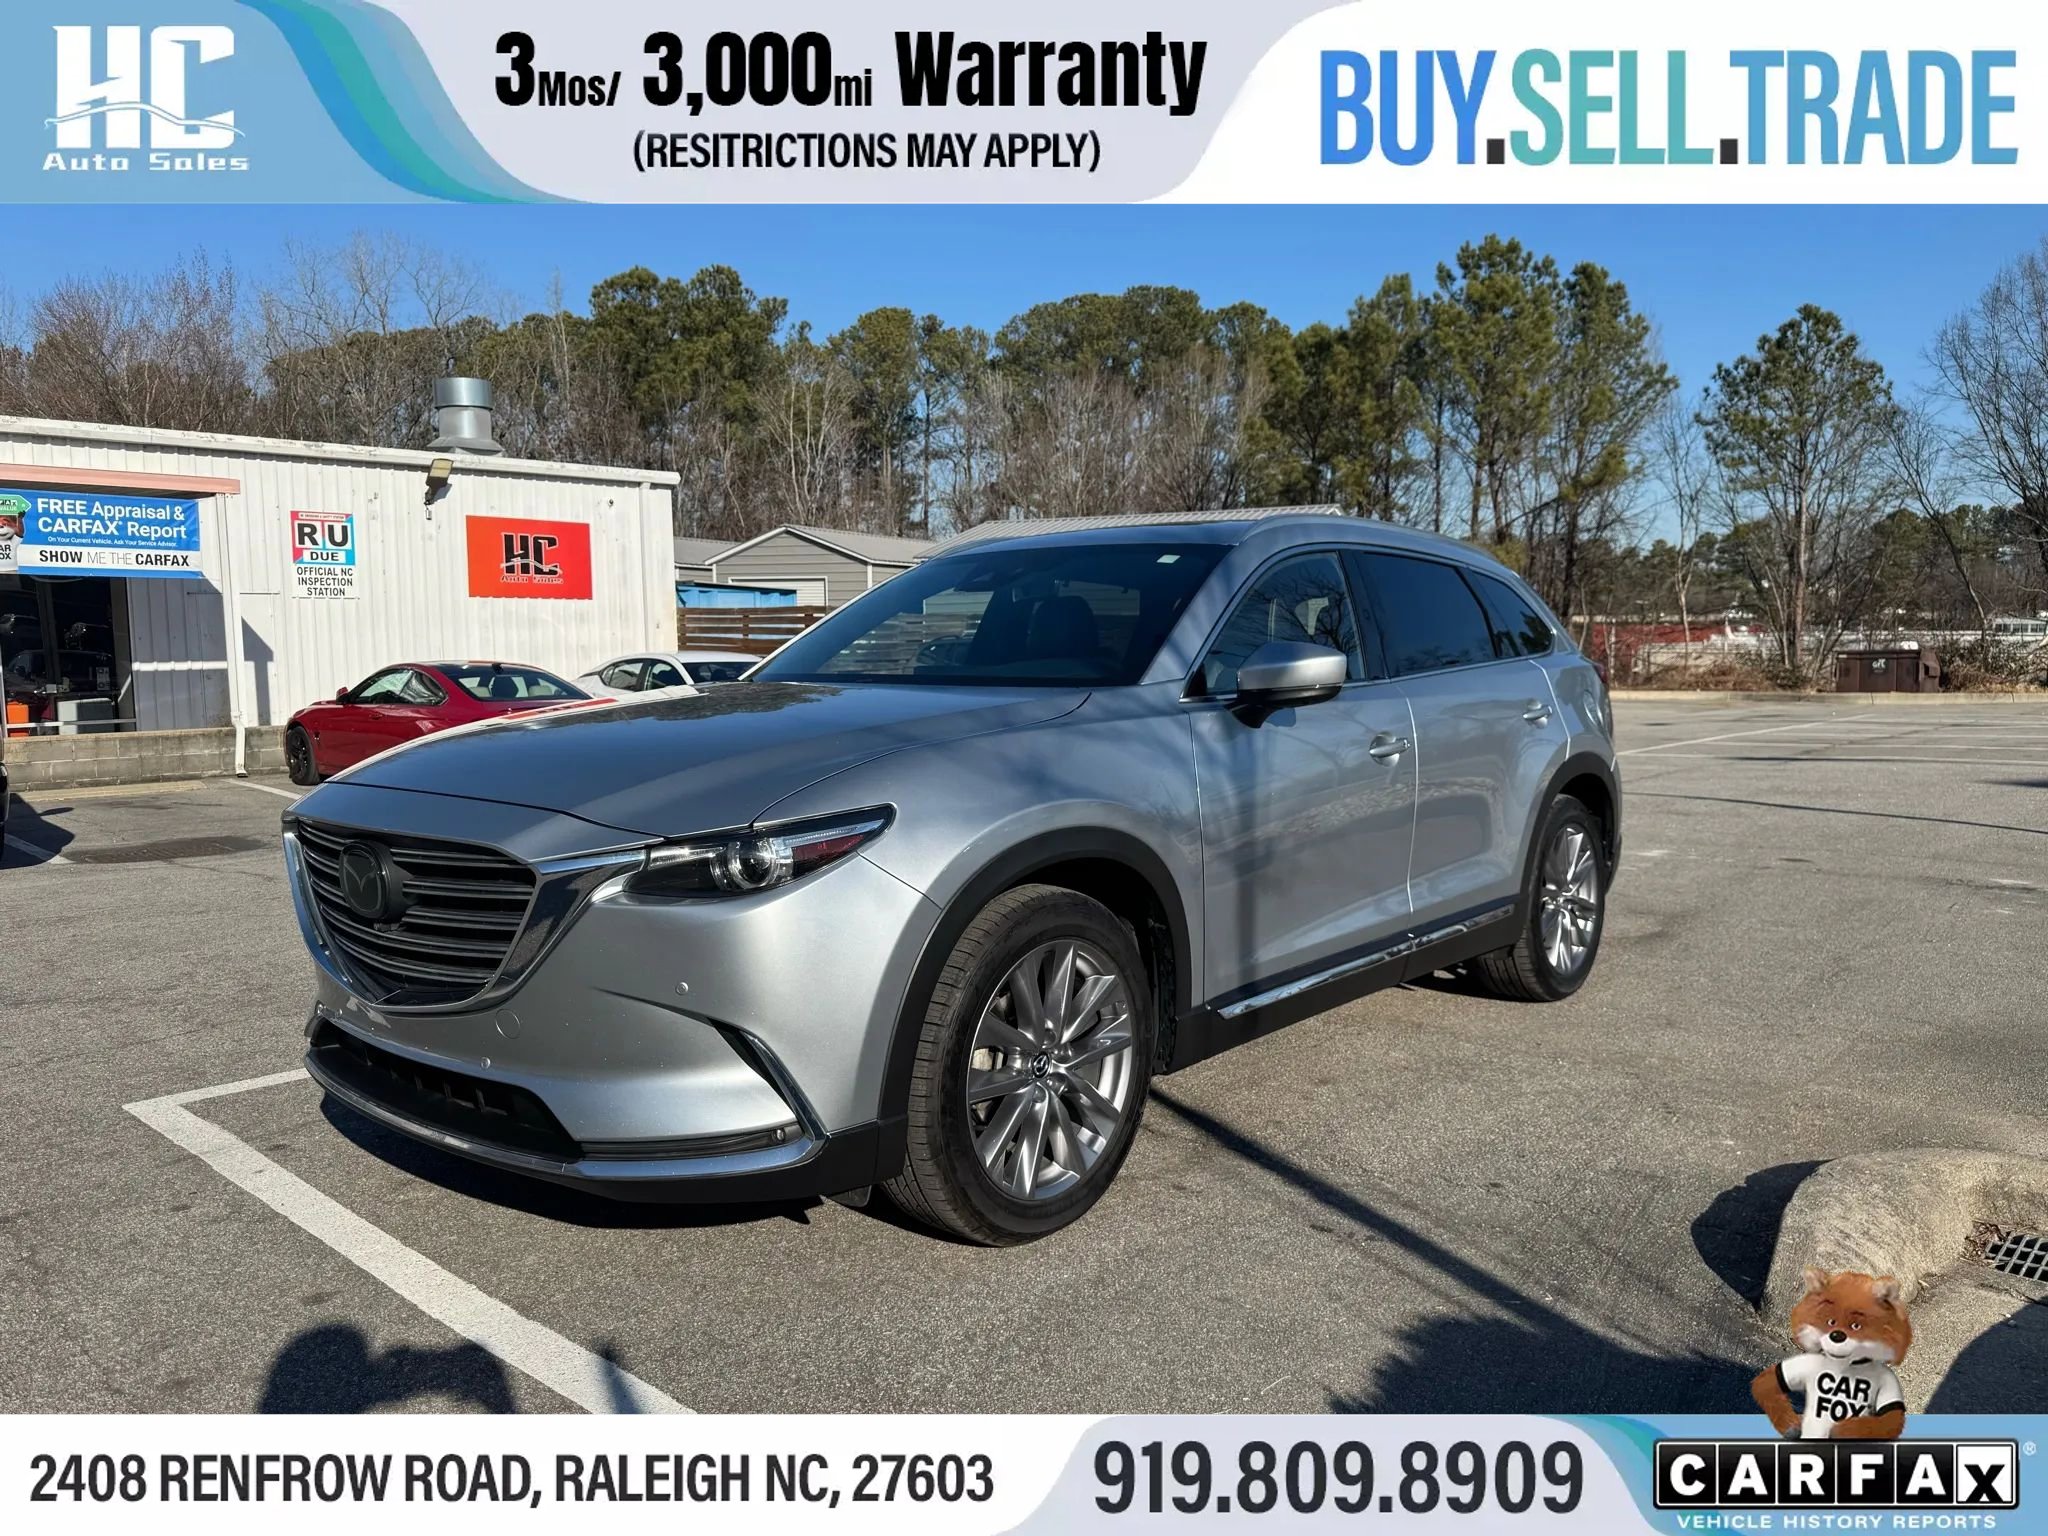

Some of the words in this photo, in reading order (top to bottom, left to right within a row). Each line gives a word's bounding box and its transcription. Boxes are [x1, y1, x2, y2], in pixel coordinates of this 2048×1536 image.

[37, 498, 88, 516] FREE
[91, 501, 171, 521] Appraisal
[173, 505, 185, 520] &
[38, 517, 120, 536] CARFAX
[127, 521, 187, 540] Report
[39, 550, 83, 563] SHOW
[87, 551, 107, 565] ME
[111, 552, 133, 566] THE
[135, 553, 190, 567] CARFAX
[310, 551, 340, 561] DUE
[502, 532, 560, 576] HC
[296, 566, 339, 577] OFFICIAL
[340, 567, 354, 577] NC
[298, 576, 353, 587] INSPECTION
[307, 586, 346, 597] STATION
